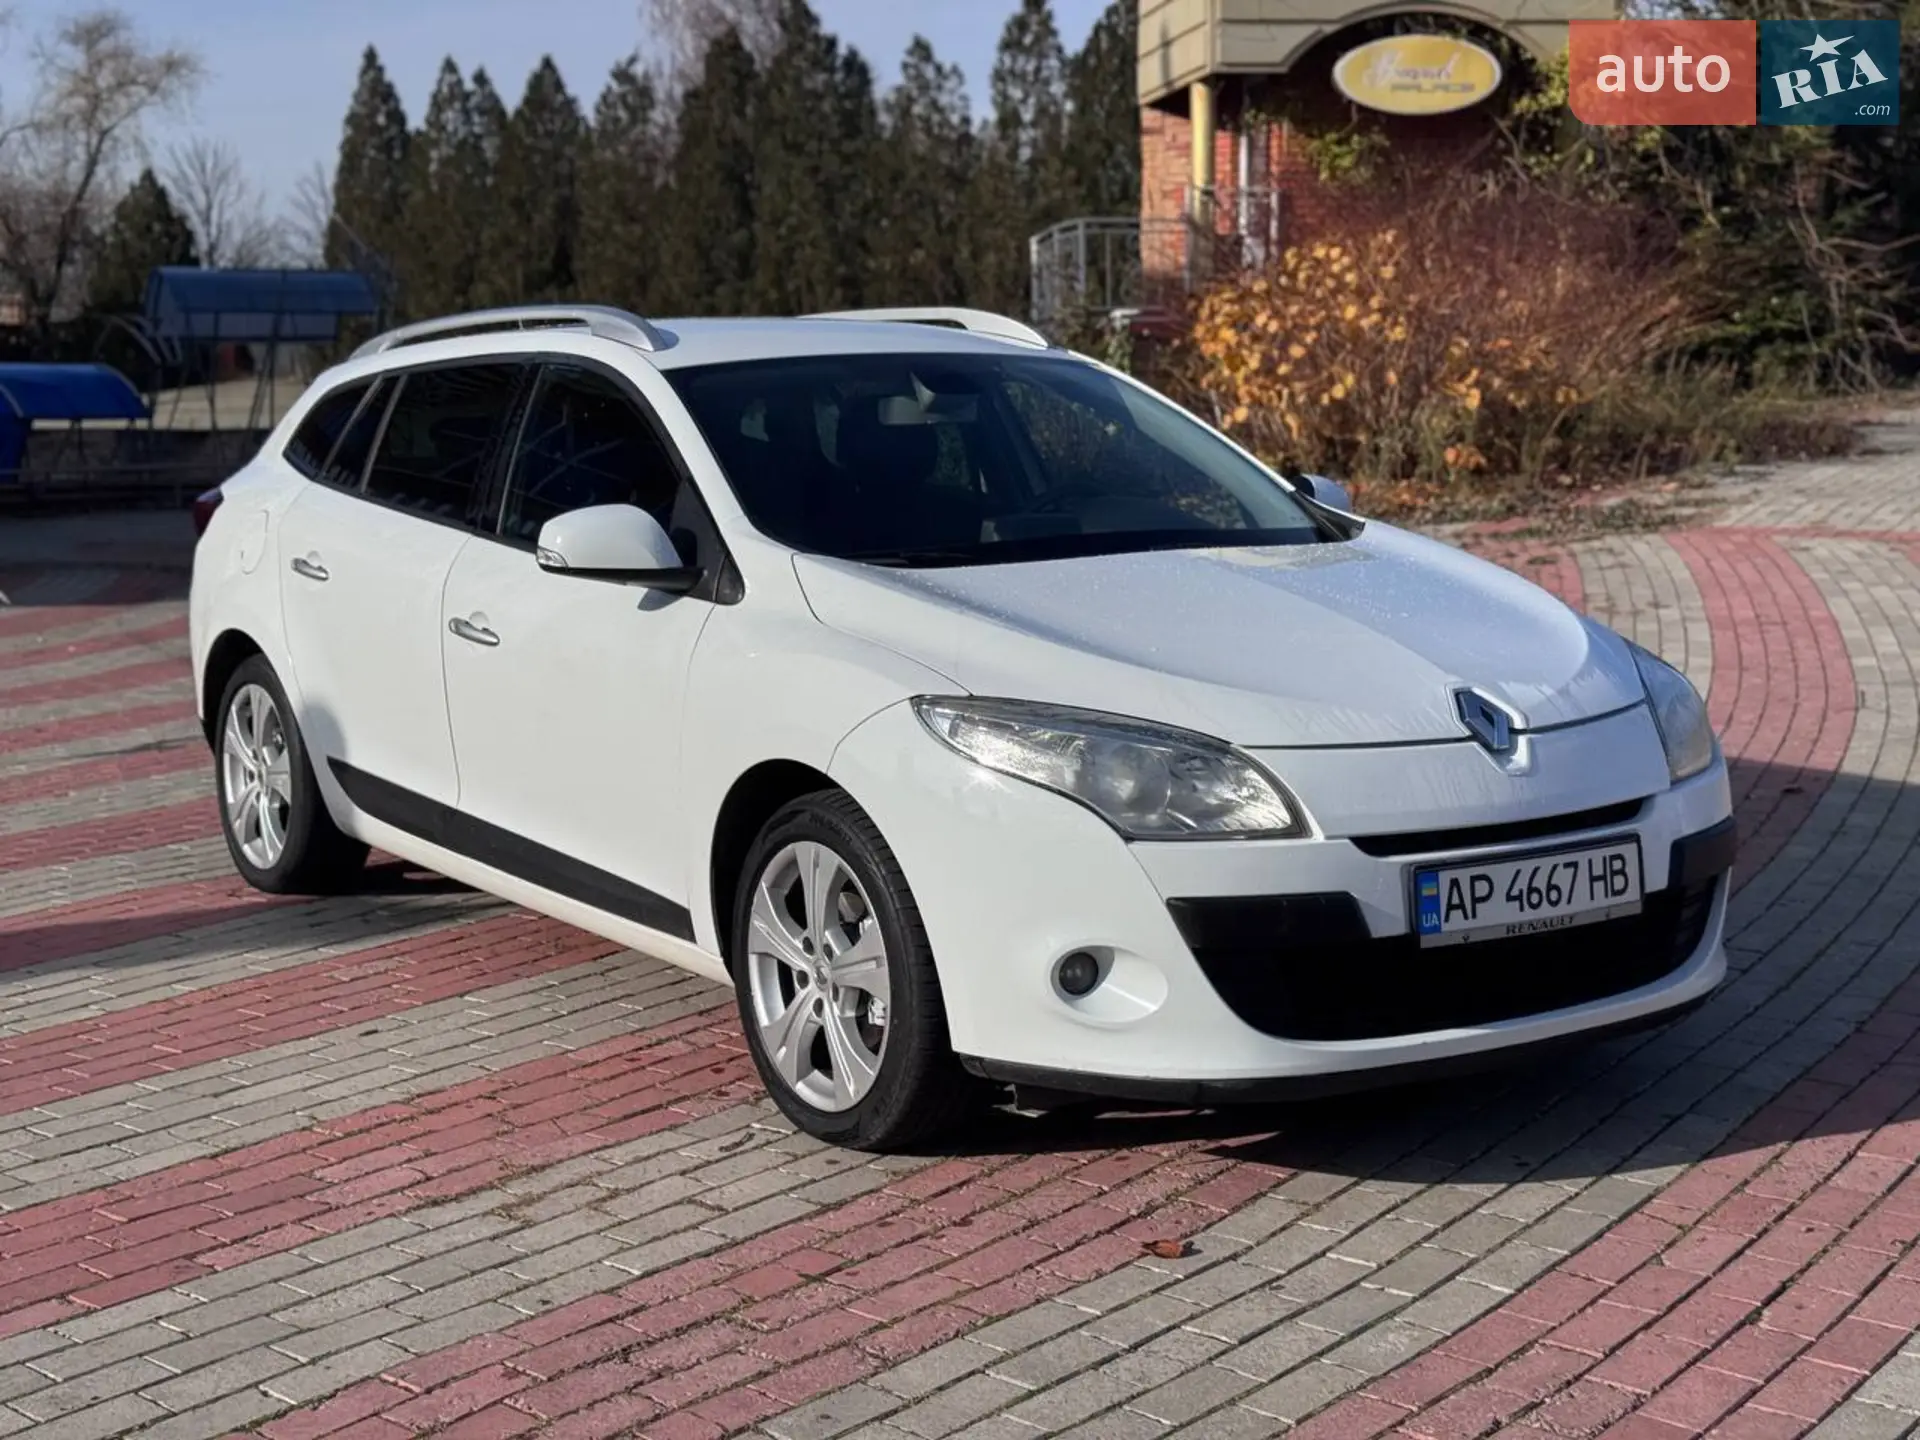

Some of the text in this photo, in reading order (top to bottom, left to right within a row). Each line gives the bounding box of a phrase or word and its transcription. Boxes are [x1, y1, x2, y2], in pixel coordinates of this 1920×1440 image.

[1444, 853, 1629, 923] AP 4667 HB
[1422, 912, 1439, 927] UA
[1505, 916, 1574, 936] RENAULT
